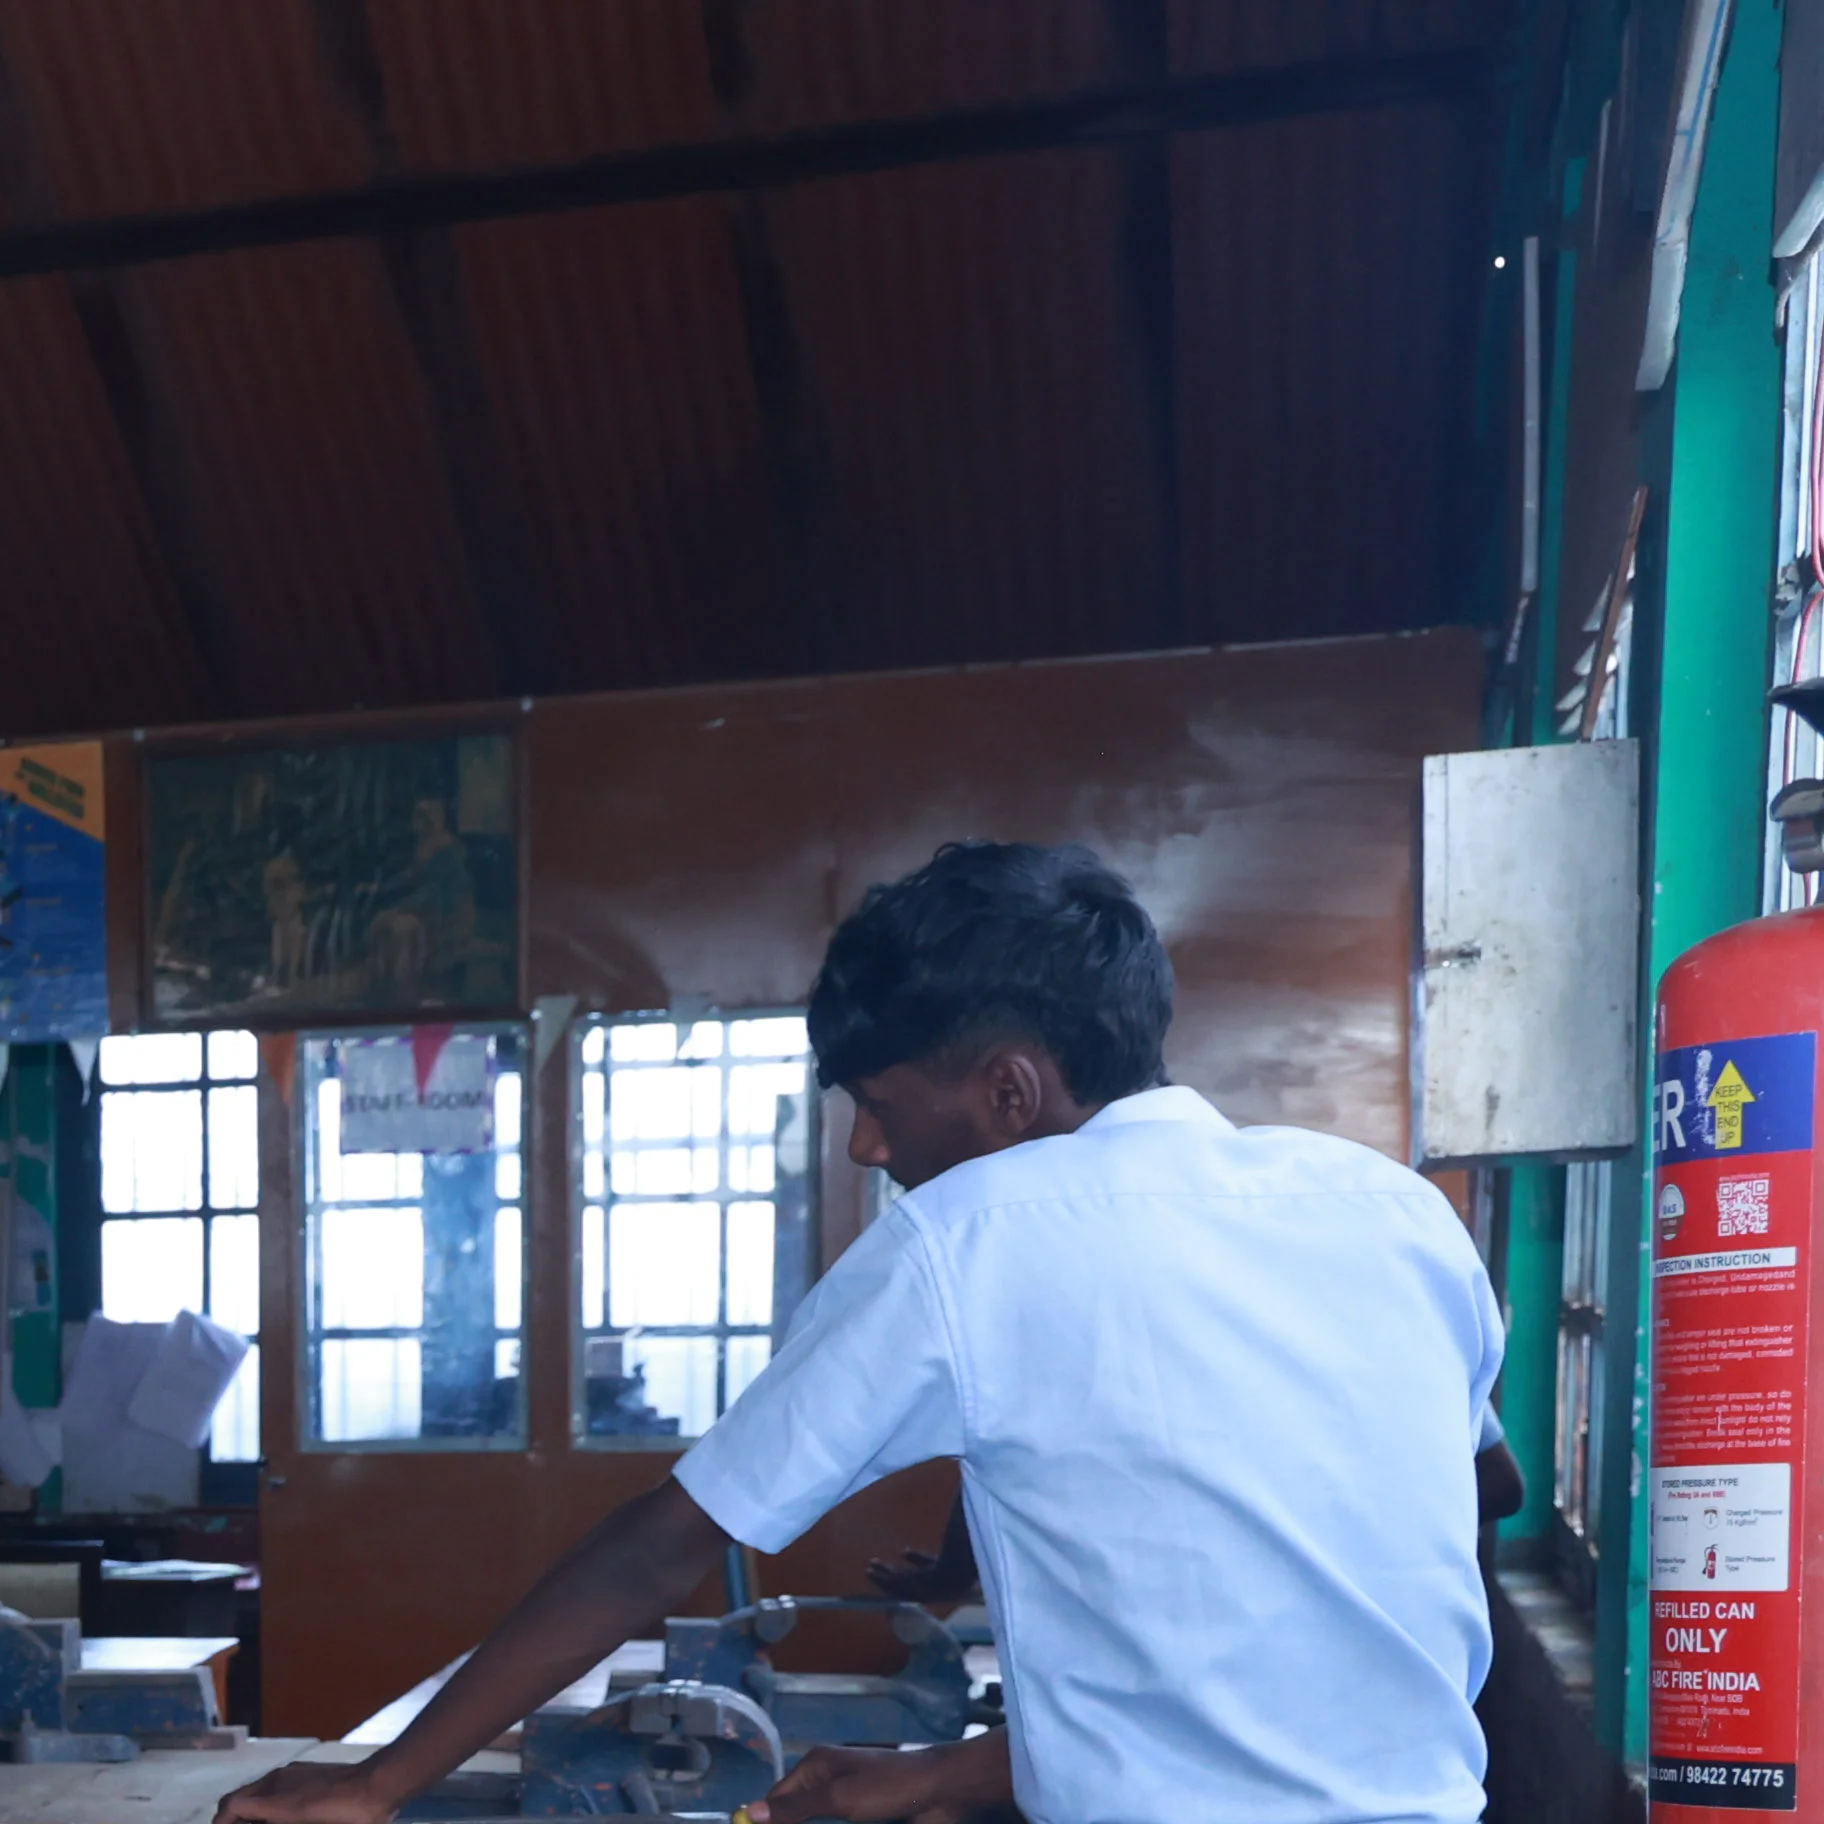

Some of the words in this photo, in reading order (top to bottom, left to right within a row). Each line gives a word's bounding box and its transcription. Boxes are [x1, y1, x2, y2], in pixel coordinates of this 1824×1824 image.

[1715, 1084, 1743, 1098] KEEP
[1717, 1100, 1741, 1112] THIS
[1717, 1116, 1740, 1129] END
[1720, 1131, 1735, 1144] UP
[1694, 1252, 1771, 1269] INSTRUCTION
[1681, 1478, 1716, 1489] PRESSURE
[1718, 1477, 1740, 1487] TYPE
[1655, 1602, 1710, 1619] REFILLED
[1715, 1602, 1755, 1619] CAN
[1665, 1627, 1728, 1654] ONLY
[1672, 1670, 1703, 1690] FIRE
[1707, 1671, 1761, 1692] INDIA
[1686, 1766, 1727, 1786] 98422
[1731, 1768, 1785, 1788] 74775
